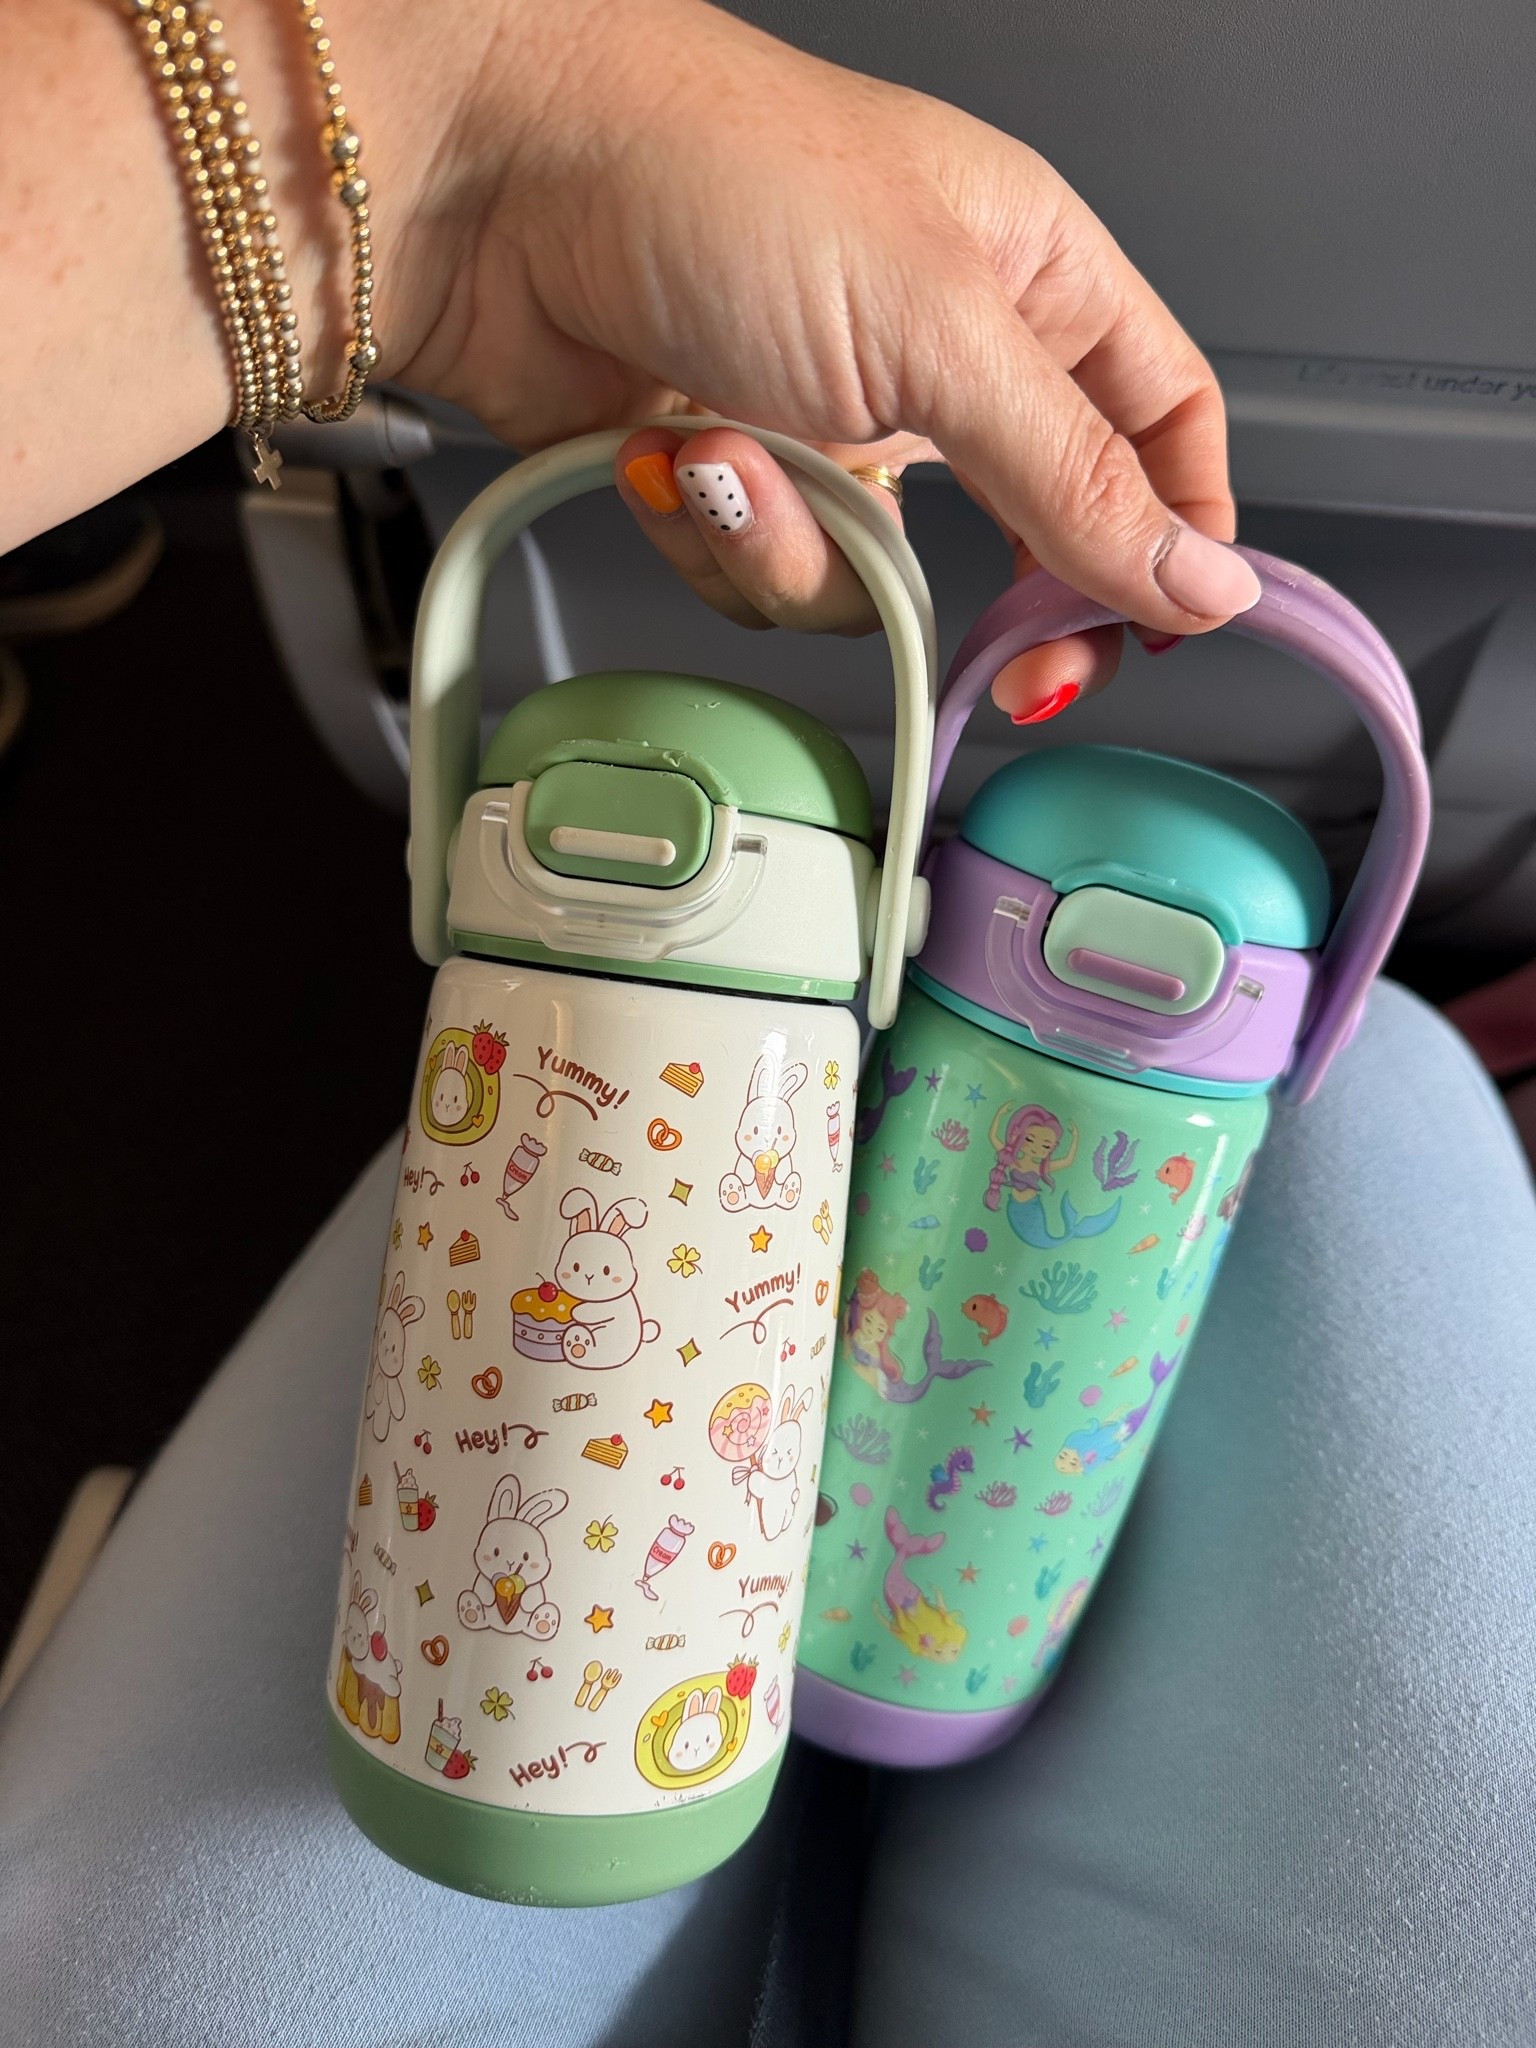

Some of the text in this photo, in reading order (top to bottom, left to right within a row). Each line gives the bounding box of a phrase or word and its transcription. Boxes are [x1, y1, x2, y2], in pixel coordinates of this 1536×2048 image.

[537, 1045, 630, 1110] Yummy!
[403, 1165, 425, 1194] Hey!
[508, 1164, 528, 1181] Cream
[724, 1262, 801, 1313] Yummy!
[455, 1421, 508, 1454] Hey!
[652, 1545, 673, 1561] Cream
[738, 1570, 793, 1598] Yummy!
[508, 1744, 568, 1787] Hey!
